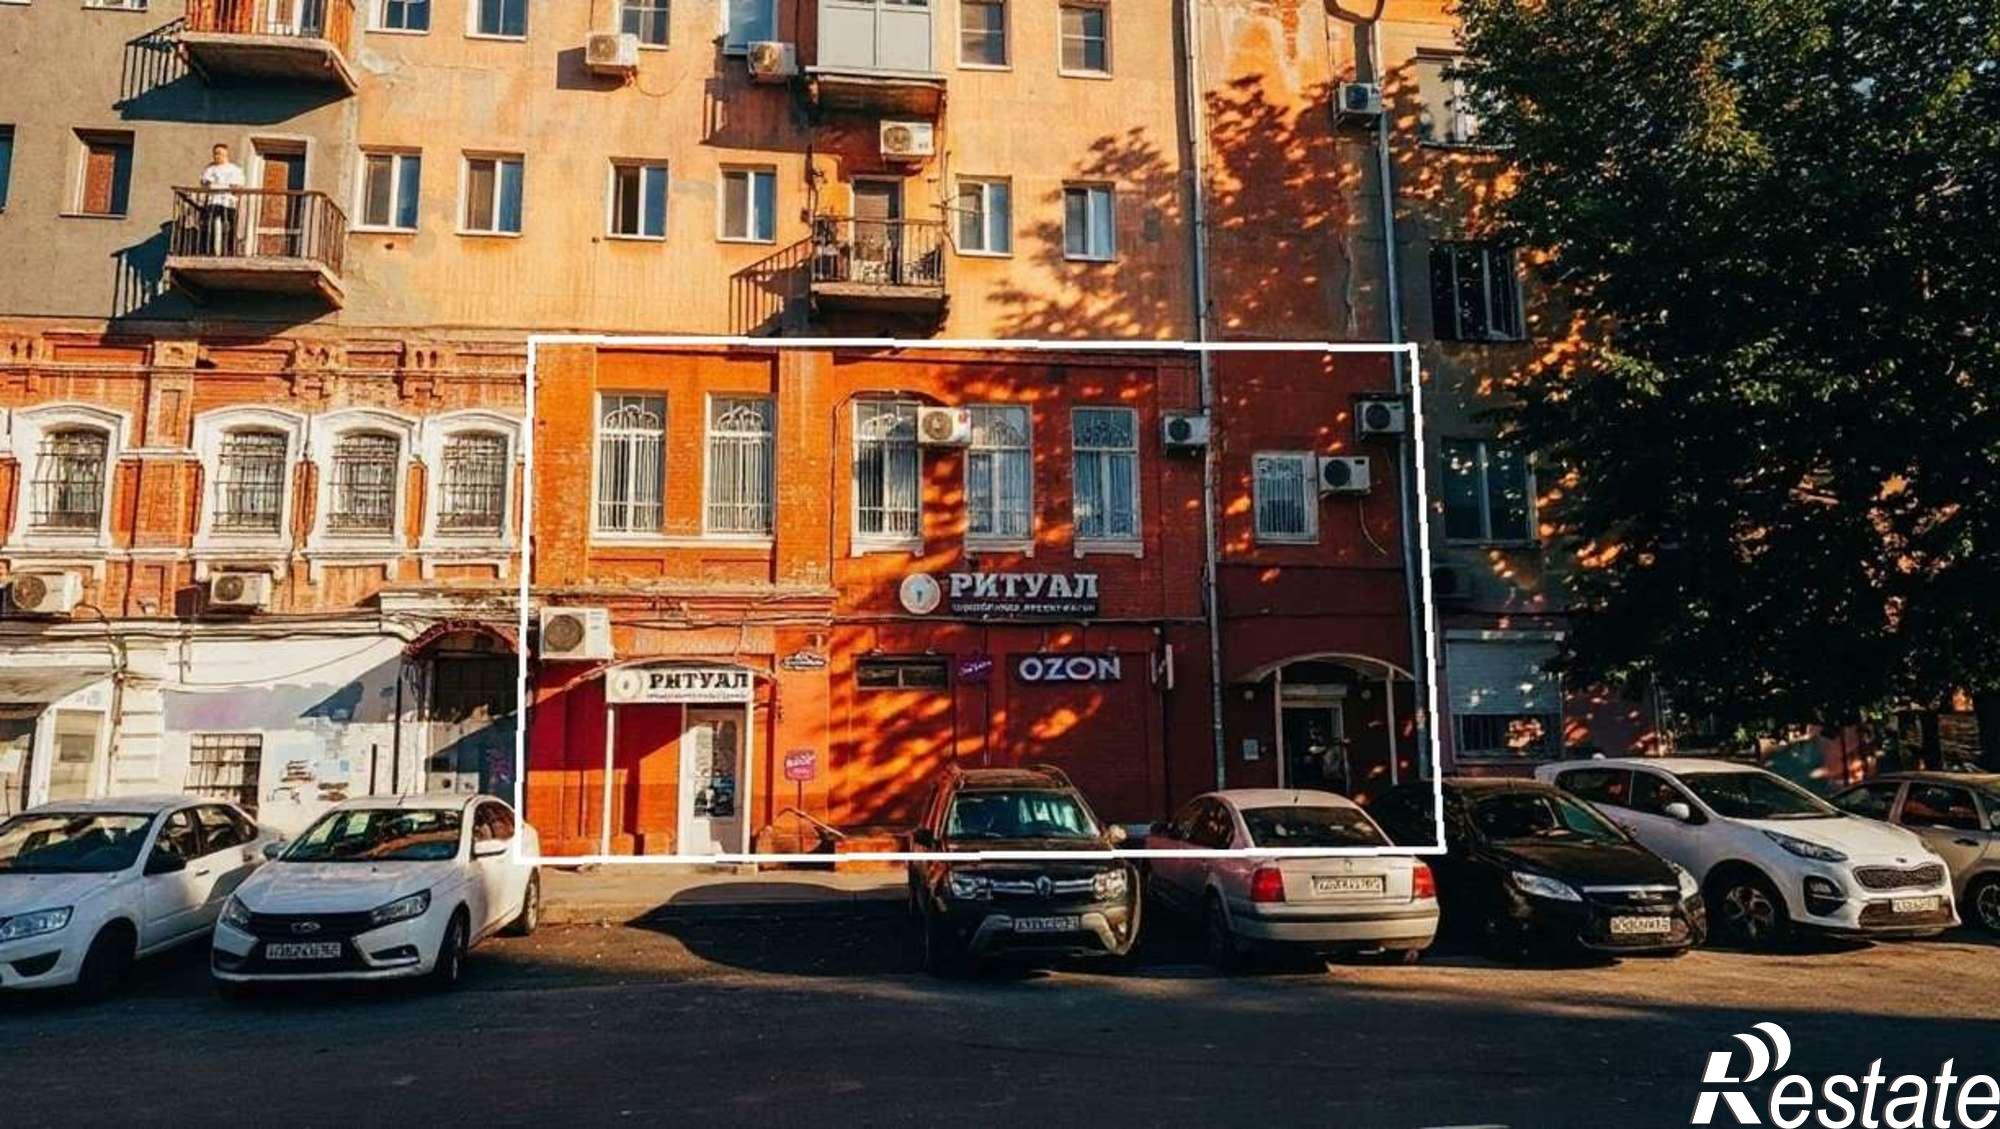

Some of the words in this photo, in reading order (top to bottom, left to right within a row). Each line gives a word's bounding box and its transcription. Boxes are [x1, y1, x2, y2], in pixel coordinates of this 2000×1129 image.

[950, 573, 1099, 598] РИТУАЛ
[649, 672, 748, 689] РИТУАЛ
[1019, 657, 1121, 681] OZON
